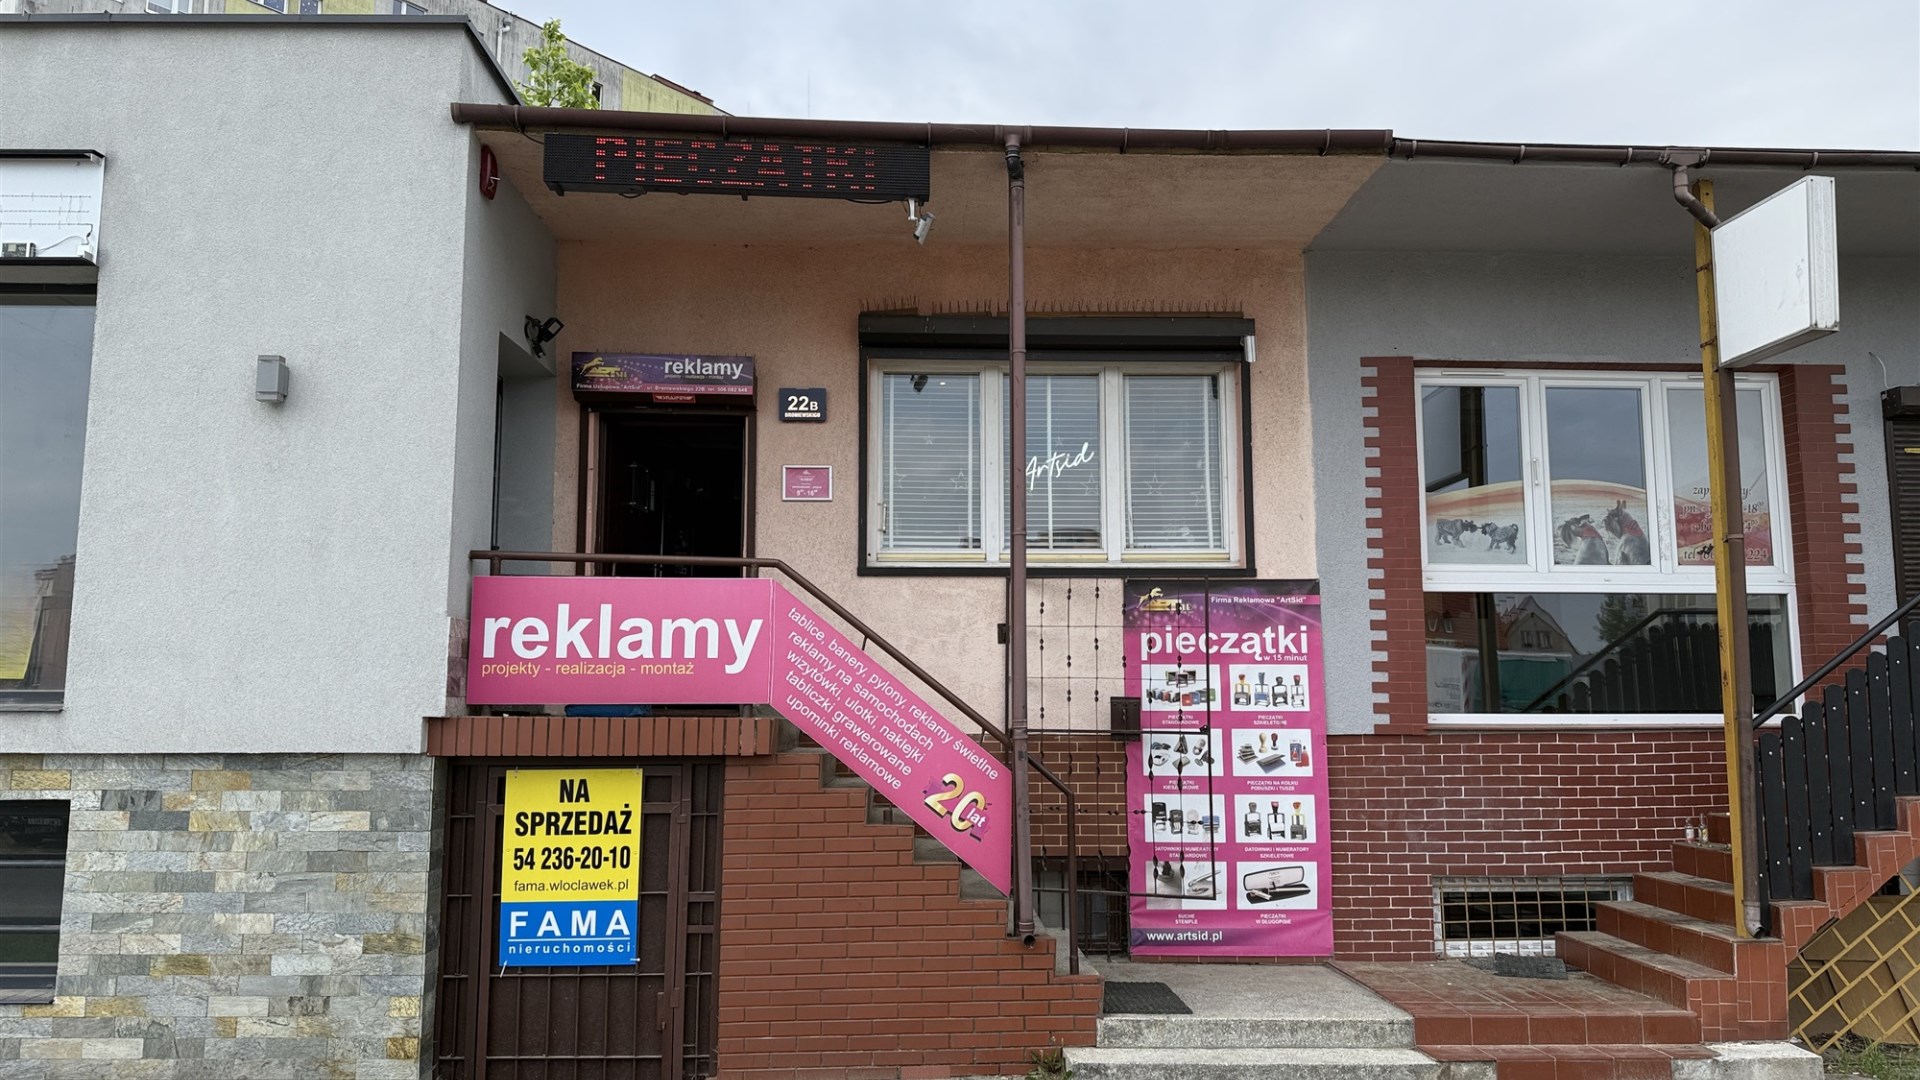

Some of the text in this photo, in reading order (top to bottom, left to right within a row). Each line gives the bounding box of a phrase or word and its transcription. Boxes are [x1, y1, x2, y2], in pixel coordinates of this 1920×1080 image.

[664, 358, 743, 379] reklamy
[787, 396, 818, 411] 22B
[1747, 549, 1767, 560] 224
[1233, 596, 1275, 604] Reklamowa
[482, 603, 764, 675] reklamy
[1140, 625, 1308, 661] pieczątki
[482, 662, 541, 676] projekty
[555, 661, 626, 676] realizacja
[640, 661, 694, 675] montaż
[788, 631, 934, 750] reklamy na samochodach
[788, 607, 999, 780] tablice, banery, pylony, reklamy świetlne
[787, 649, 926, 764] wizytówki, ulotki, naklejki
[786, 670, 912, 776] tabliczki grawerowane
[786, 694, 903, 790] upominki reklamowe
[559, 779, 590, 803] NA
[515, 803, 633, 836] SPRZEDAŻ
[965, 807, 986, 829] lat
[513, 845, 631, 870] 54 236-20-10
[514, 879, 629, 893] fama.wloclawek.pl
[510, 909, 630, 937] FAMA
[509, 942, 631, 954] nieruchomości
[1147, 931, 1223, 943] www.artsid.pl
